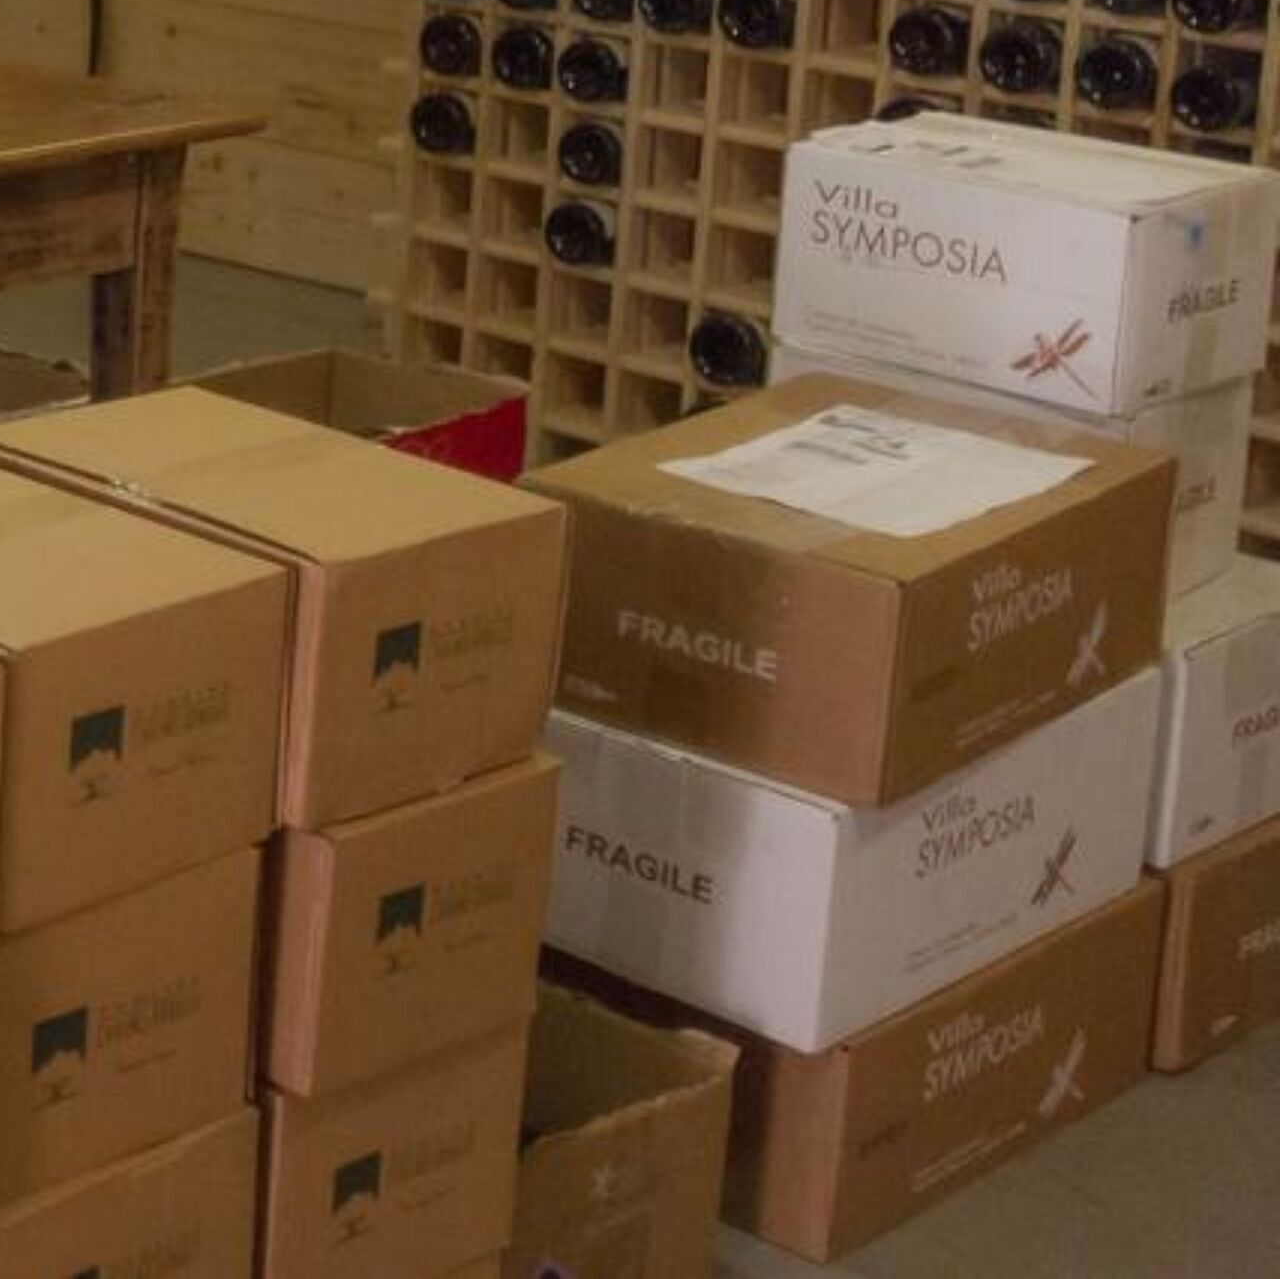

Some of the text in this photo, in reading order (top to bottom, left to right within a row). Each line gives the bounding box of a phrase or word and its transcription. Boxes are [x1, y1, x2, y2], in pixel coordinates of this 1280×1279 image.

[814, 179, 899, 219] Villa
[810, 210, 1008, 283] SYMPOSIA
[1168, 279, 1241, 322] FRAGILE
[966, 569, 1074, 653] SYMPOSIA
[971, 563, 1022, 603] Villa
[617, 609, 779, 683] FRAGILE
[916, 794, 1039, 878] SYMPOSIA
[923, 794, 978, 833] Villa
[566, 825, 715, 905] FRAGILE
[923, 1002, 1044, 1104] SYMPOSIA
[927, 1008, 986, 1054] Villa
